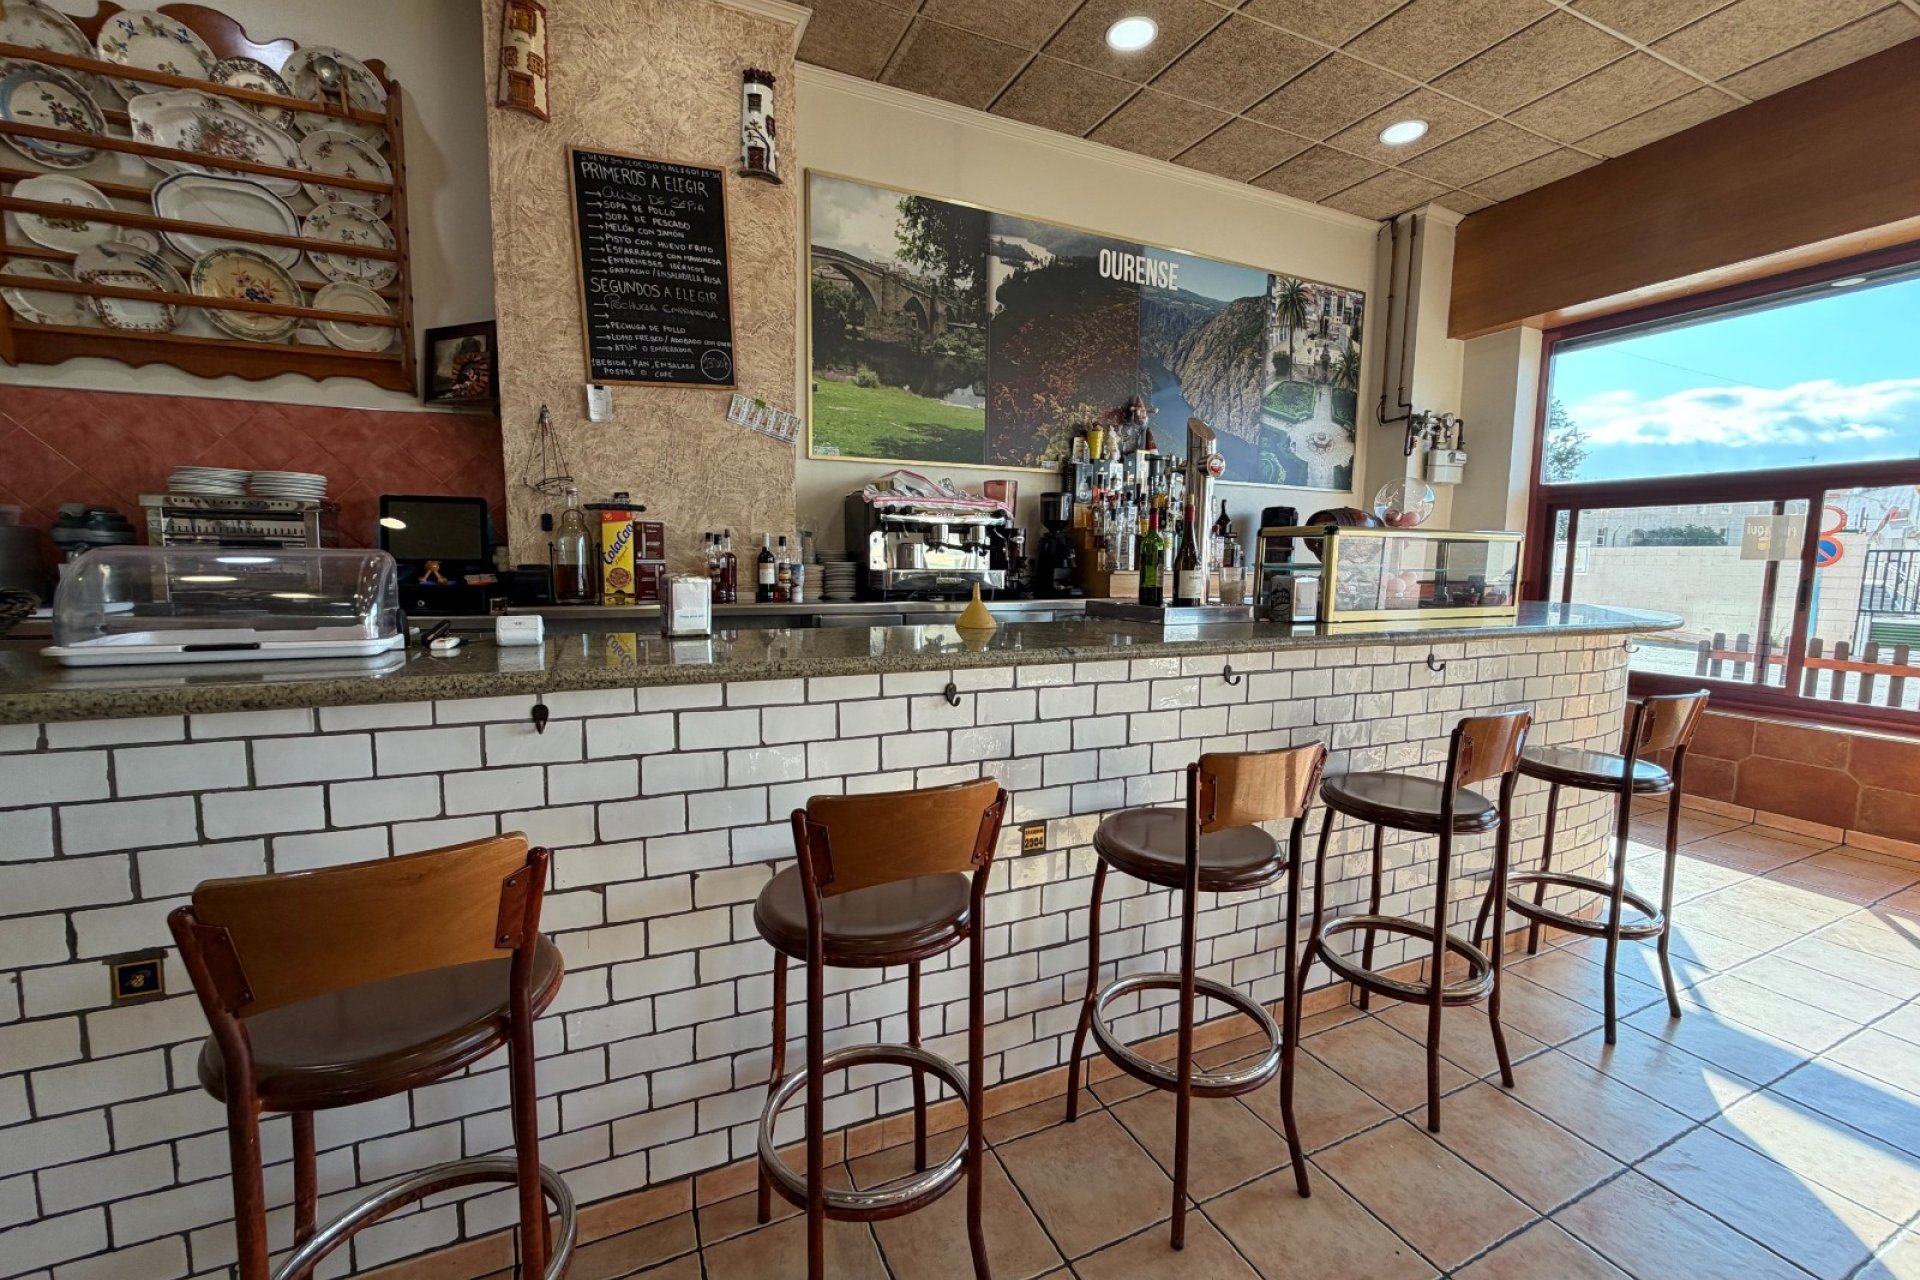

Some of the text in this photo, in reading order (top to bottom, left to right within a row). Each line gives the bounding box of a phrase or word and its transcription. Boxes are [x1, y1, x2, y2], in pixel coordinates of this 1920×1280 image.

[581, 161, 708, 198] PRIMEROS A ELEGIR
[603, 200, 676, 217] SOPA DE POLLO
[604, 212, 691, 231] SOPA DE PESCADO
[604, 221, 684, 239] MELÓN CON JAMÓN
[605, 233, 714, 254] PISTO CON HUEVO FRITO
[607, 255, 664, 268] ENTREMESES
[1099, 248, 1179, 291] OURENSE
[590, 277, 719, 305] SEGUNDOS A ELEGIR
[610, 321, 686, 334] PECHUGA DE POLLO
[611, 333, 632, 341] LOMO
[635, 334, 663, 342] FRESCO
[603, 367, 635, 376] POSTRE
[600, 524, 634, 565] ColaCao
